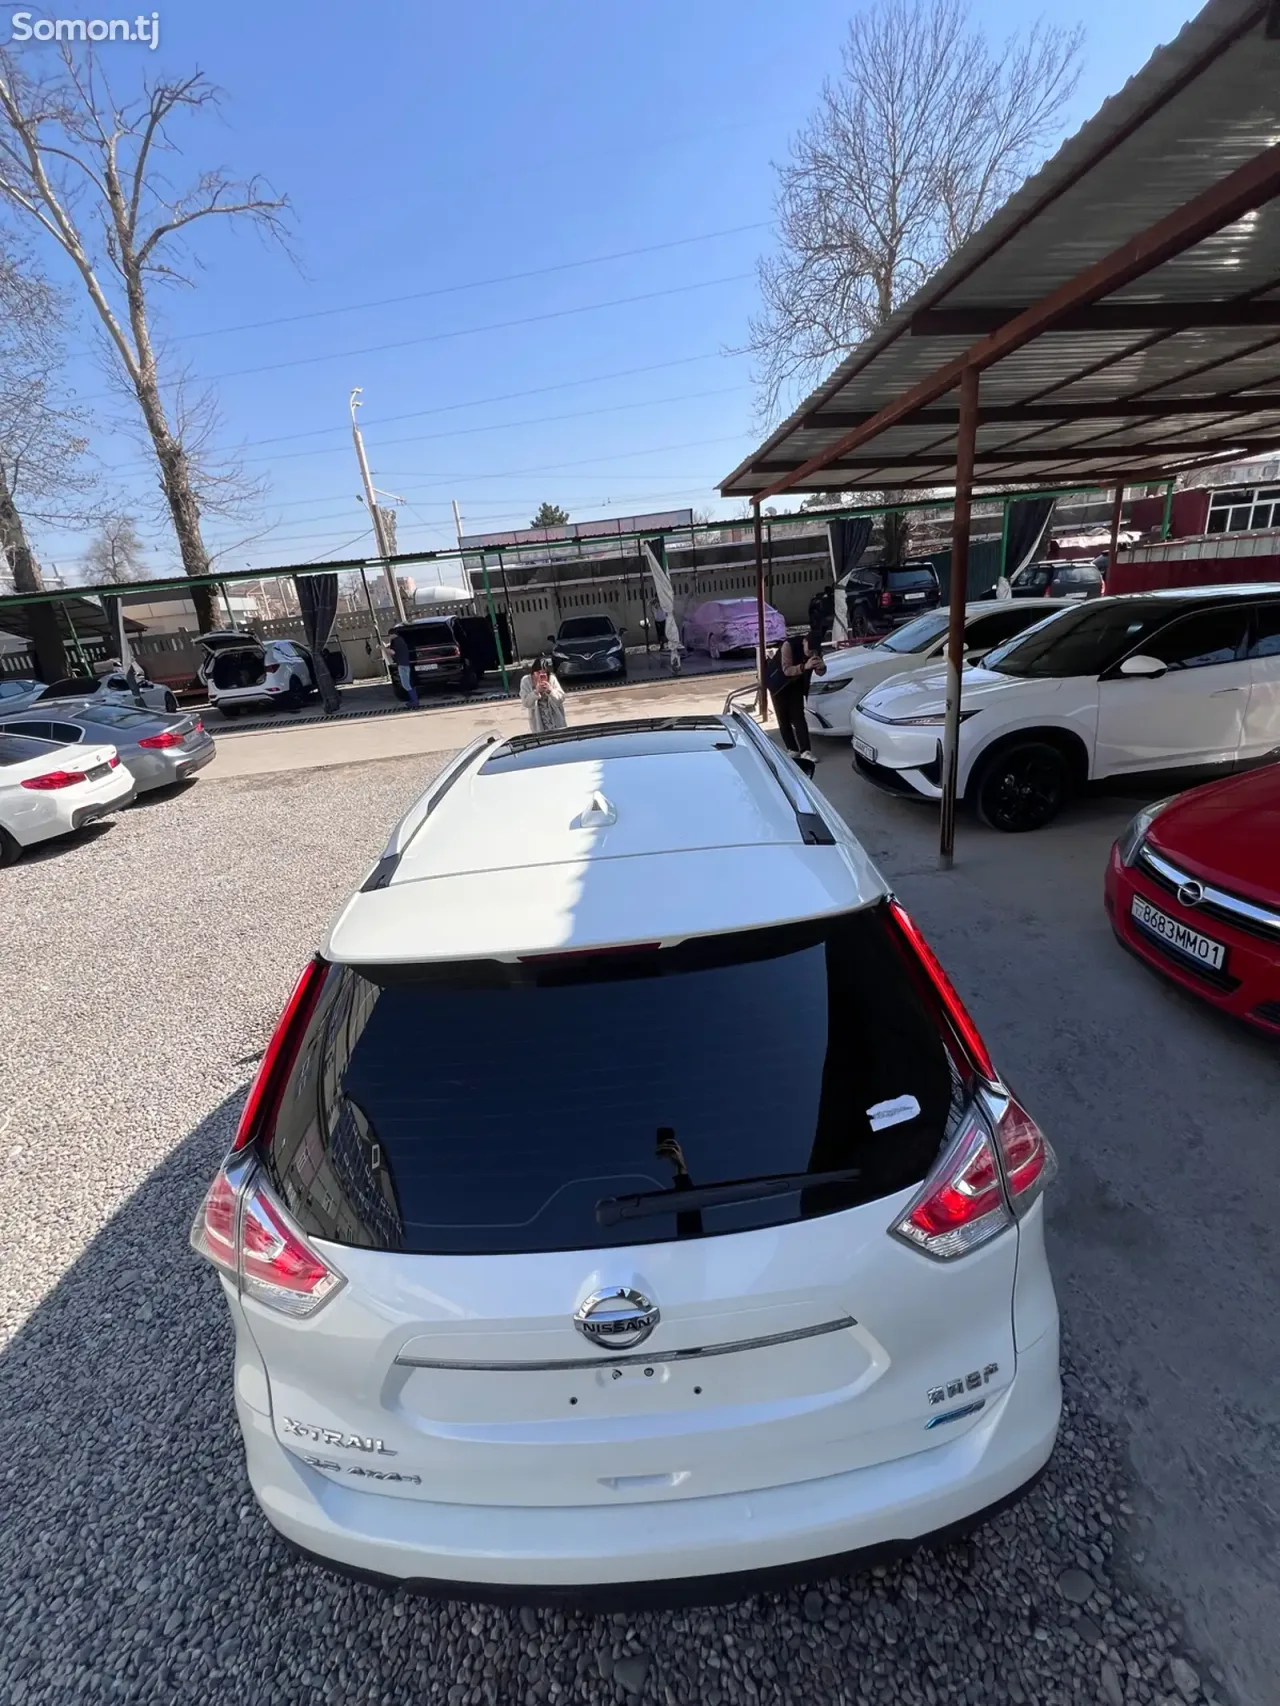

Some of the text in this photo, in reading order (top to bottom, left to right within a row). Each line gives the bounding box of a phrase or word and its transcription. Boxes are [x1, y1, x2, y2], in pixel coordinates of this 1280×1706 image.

[1143, 905, 1220, 965] 8683MM01
[583, 1317, 651, 1334] NISSAN
[283, 1416, 398, 1456] X-TRAIL
